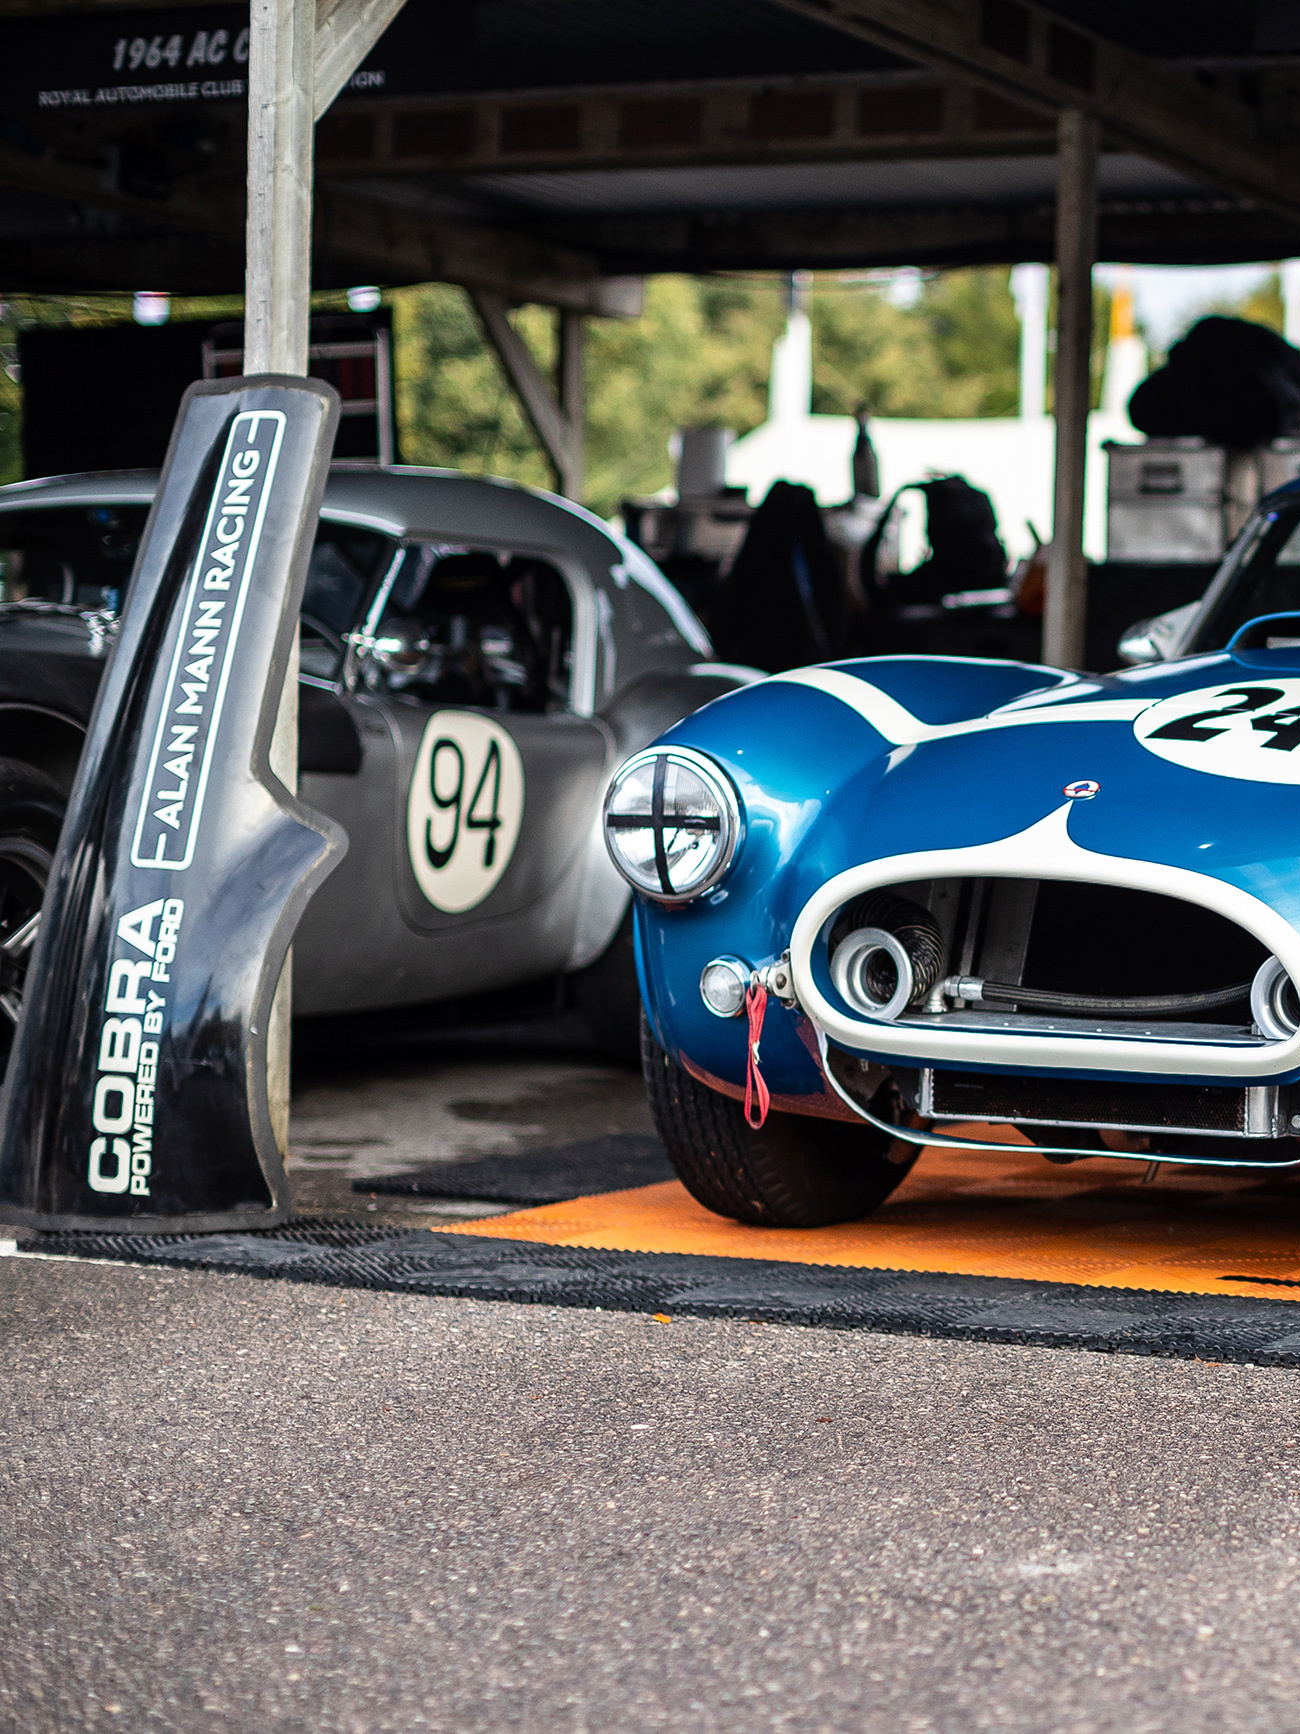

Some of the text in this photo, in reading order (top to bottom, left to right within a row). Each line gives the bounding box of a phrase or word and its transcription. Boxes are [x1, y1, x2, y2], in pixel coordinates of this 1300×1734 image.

[38, 78, 243, 107] ROYAL AUTOMOBILE CLUB
[112, 34, 184, 71] 1964
[186, 28, 229, 68] AC
[153, 449, 261, 831] ALAN MANN RACING
[425, 739, 502, 869] 94
[88, 898, 164, 1194] COBRA
[130, 898, 185, 1196] POWERED BY FORD
